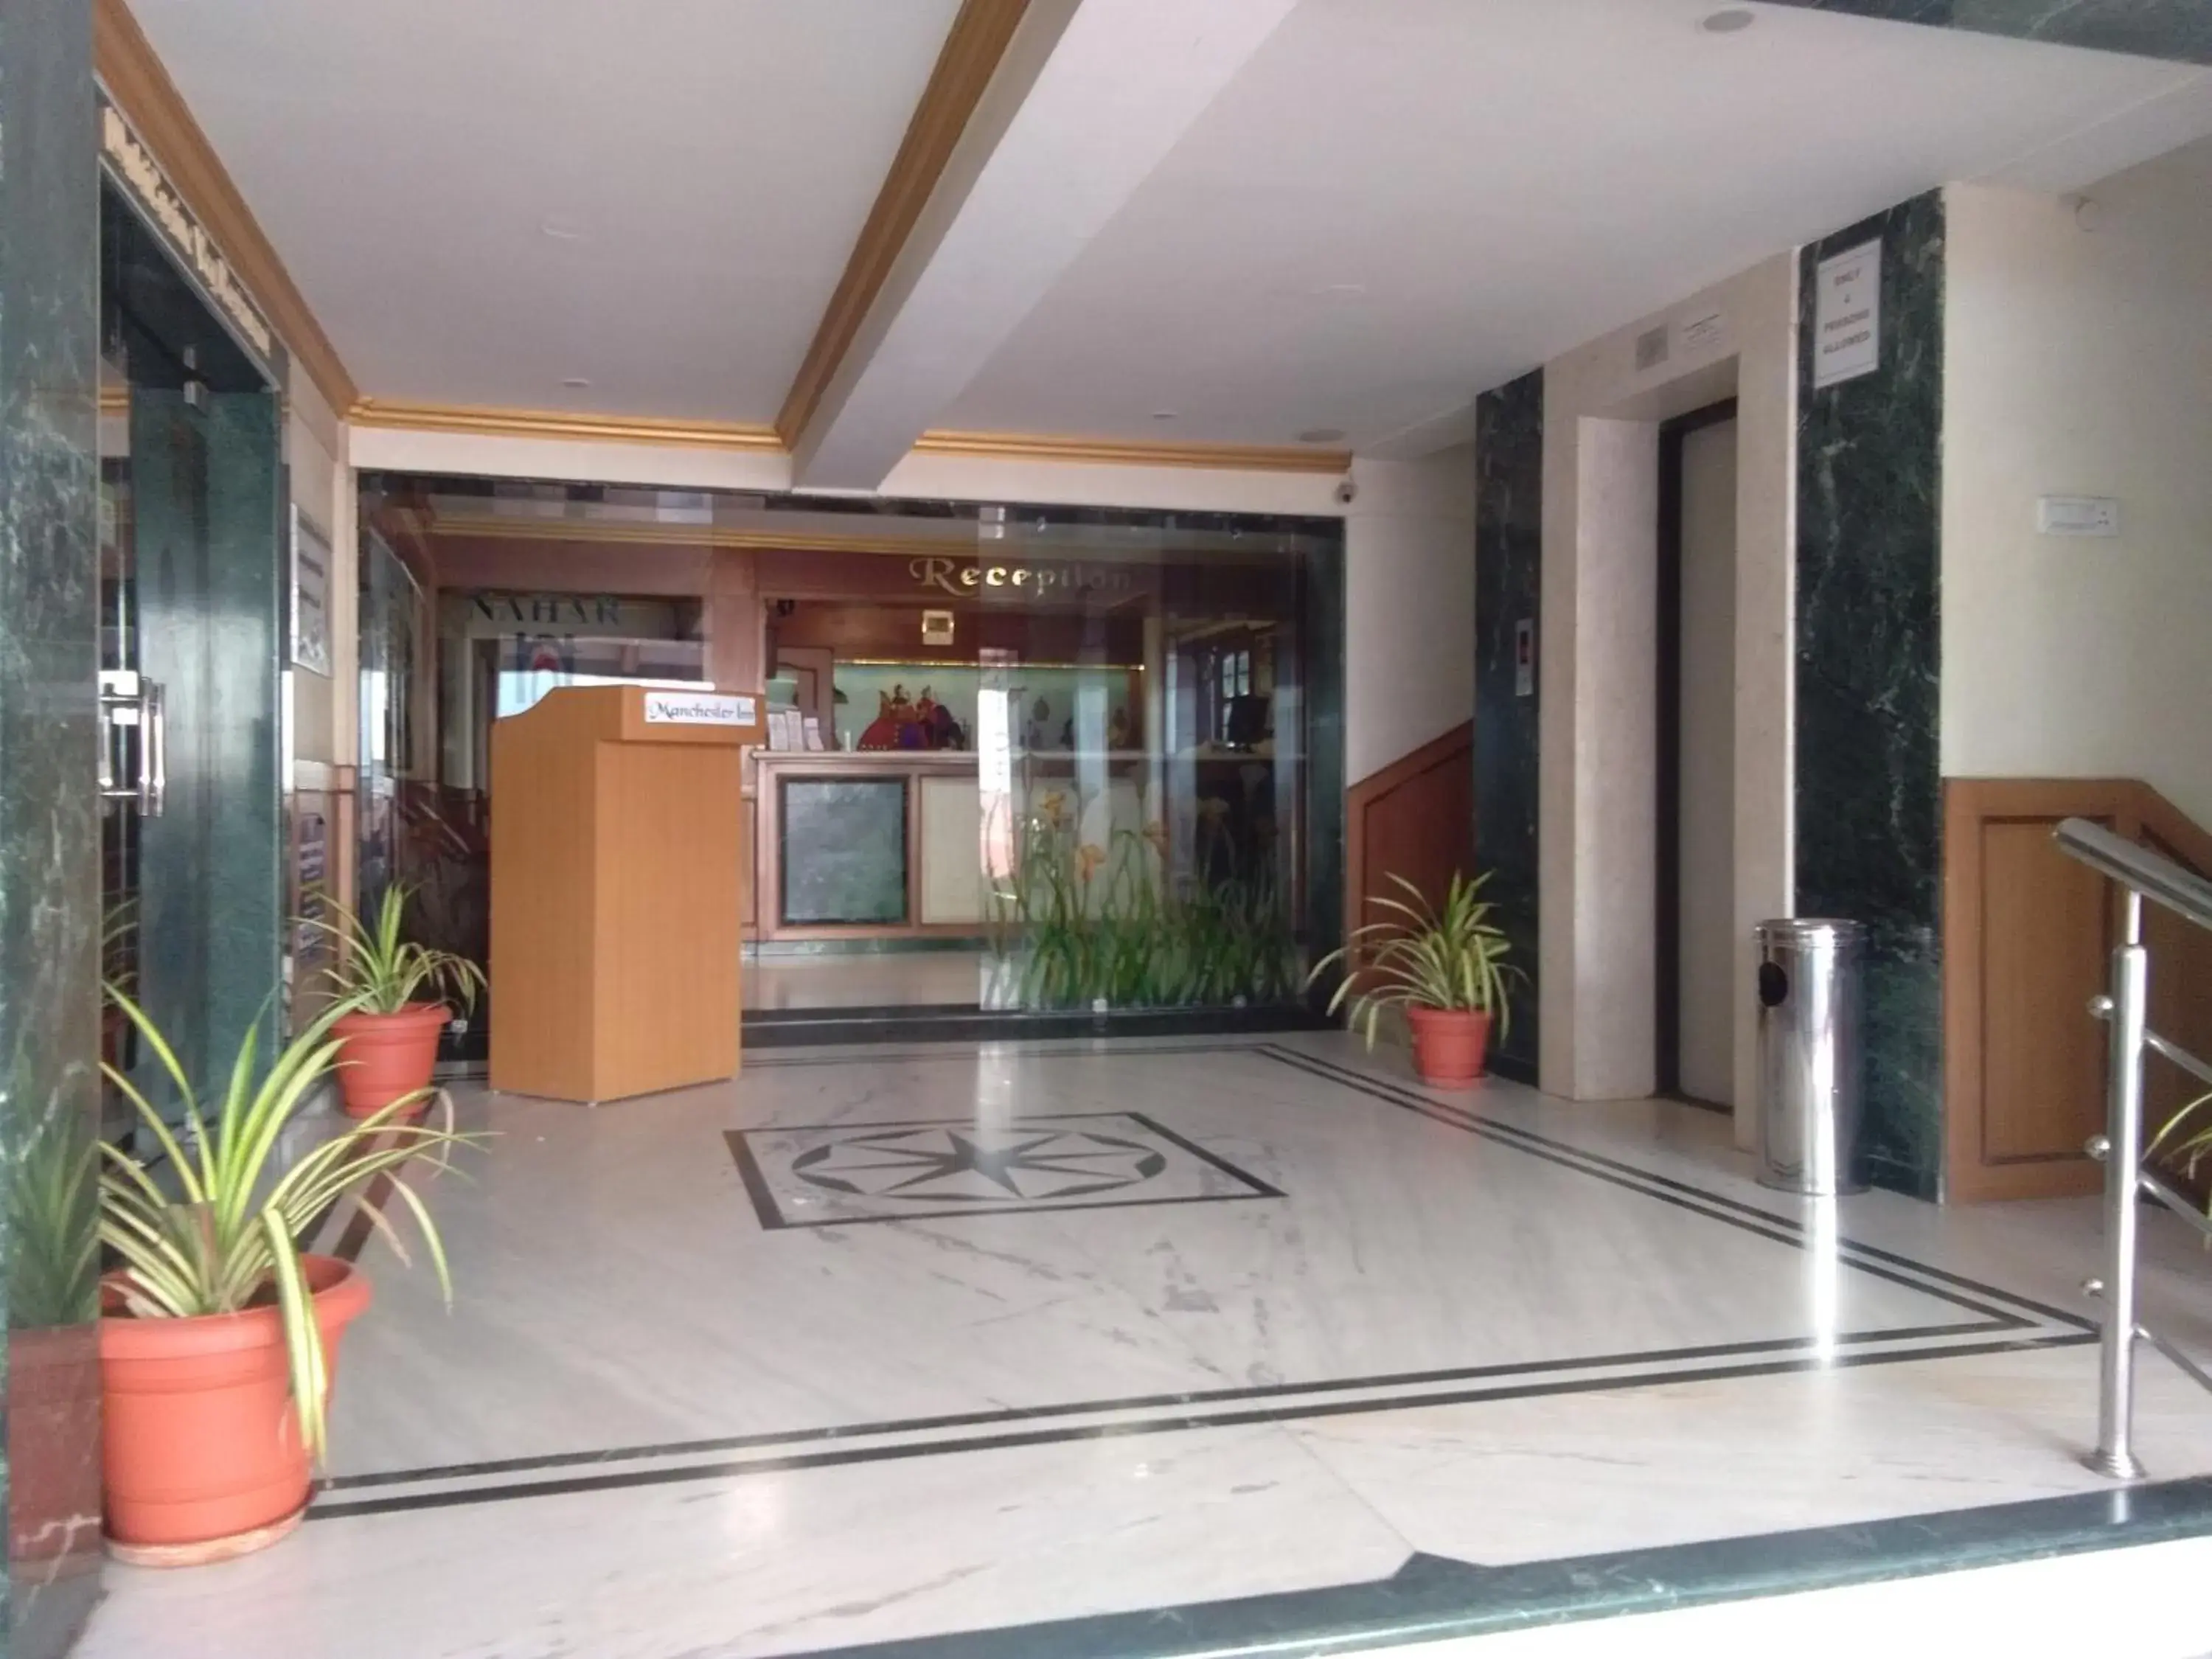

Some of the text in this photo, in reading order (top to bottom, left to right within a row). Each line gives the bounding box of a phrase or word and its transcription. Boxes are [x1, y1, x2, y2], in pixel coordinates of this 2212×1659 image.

[908, 557, 1132, 597] Reception
[470, 592, 620, 625] NAHAR
[649, 700, 735, 720] Manchester
